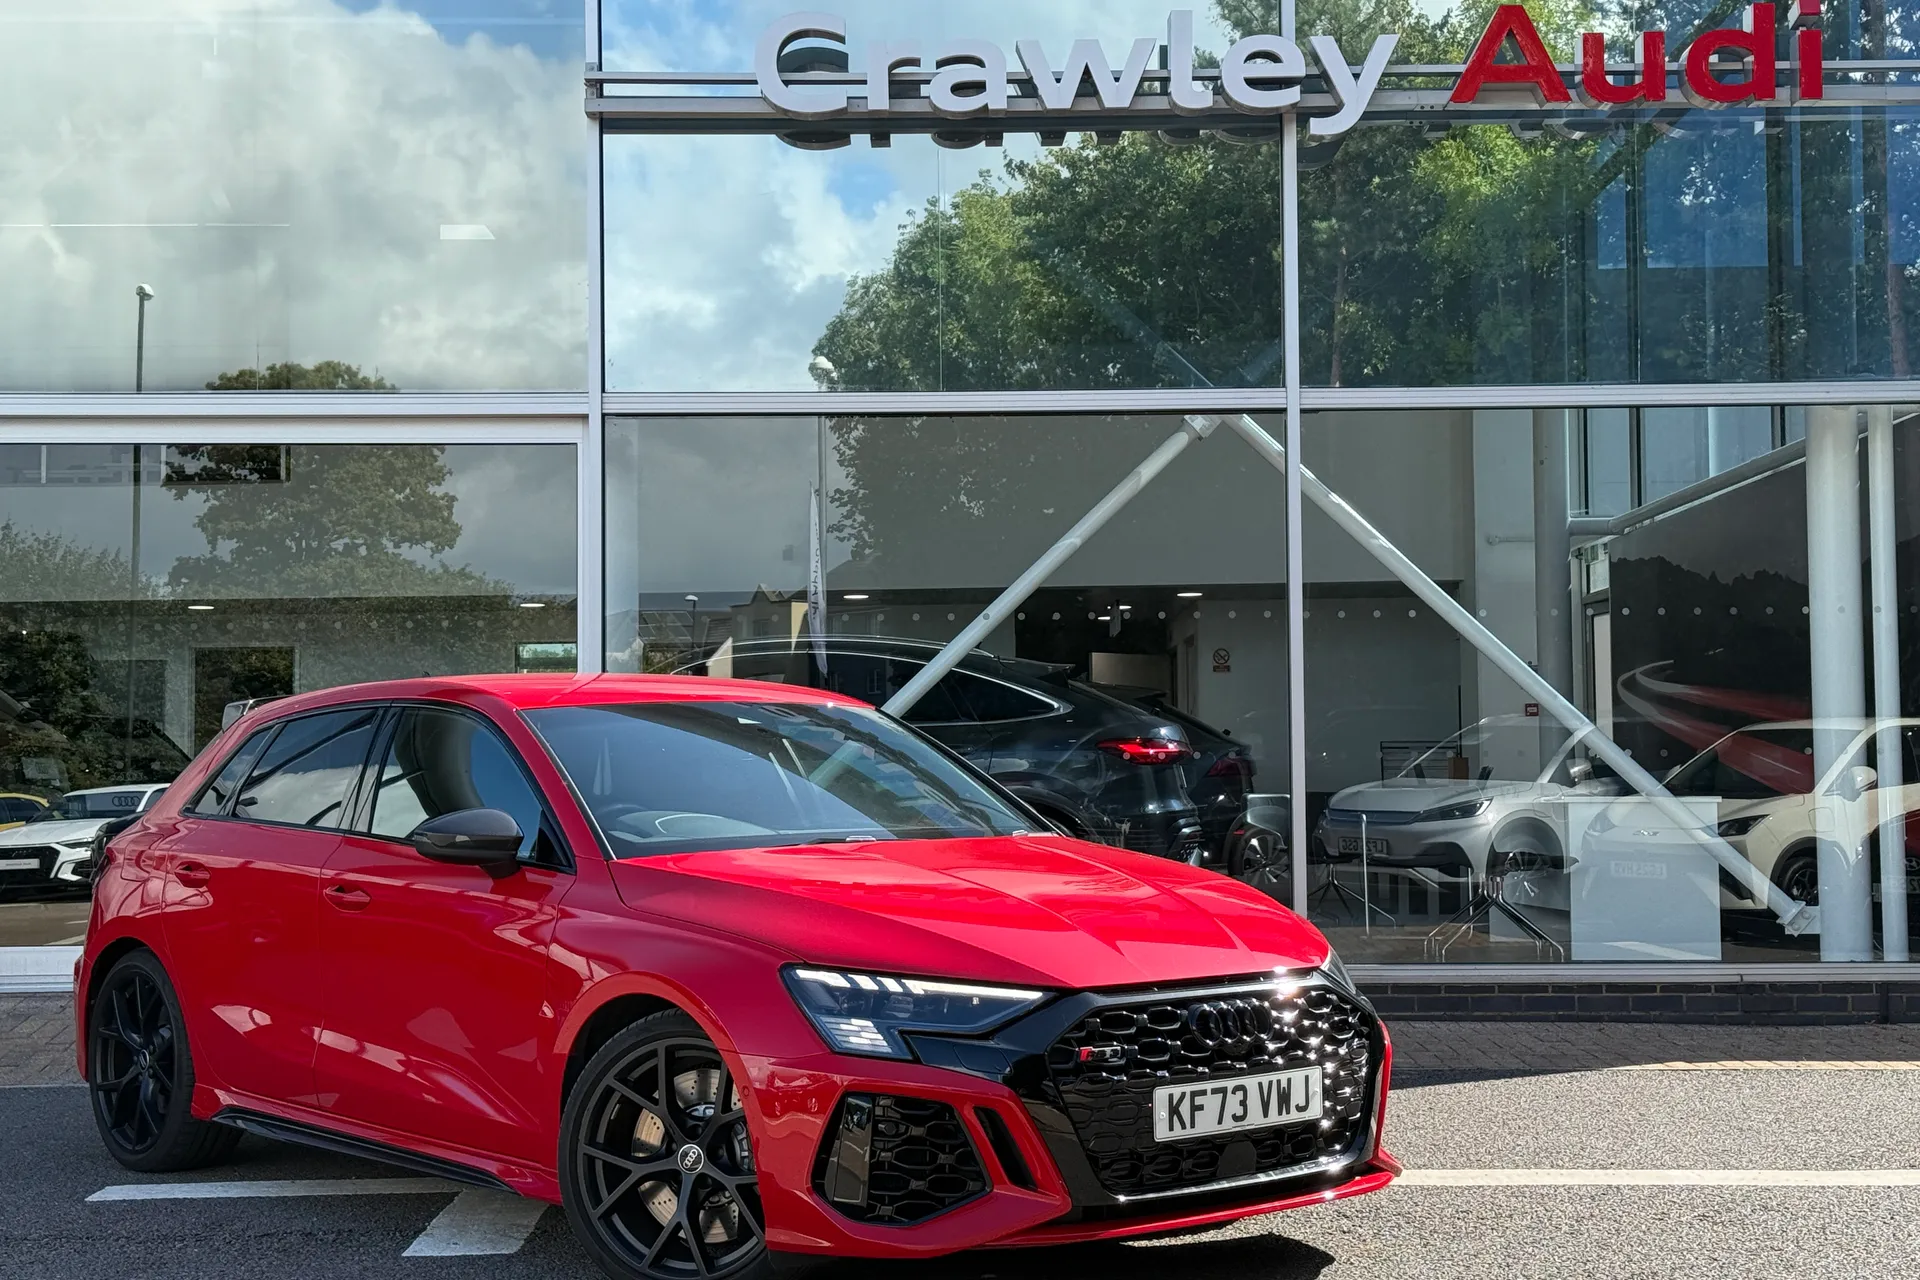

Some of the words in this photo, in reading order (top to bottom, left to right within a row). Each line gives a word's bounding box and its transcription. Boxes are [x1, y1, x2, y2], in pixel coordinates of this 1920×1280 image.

[754, 10, 1400, 139] Crawley
[1449, 1, 1826, 107] Audi
[1167, 1084, 1248, 1132] KF73
[1257, 1074, 1310, 1119] VWJ
